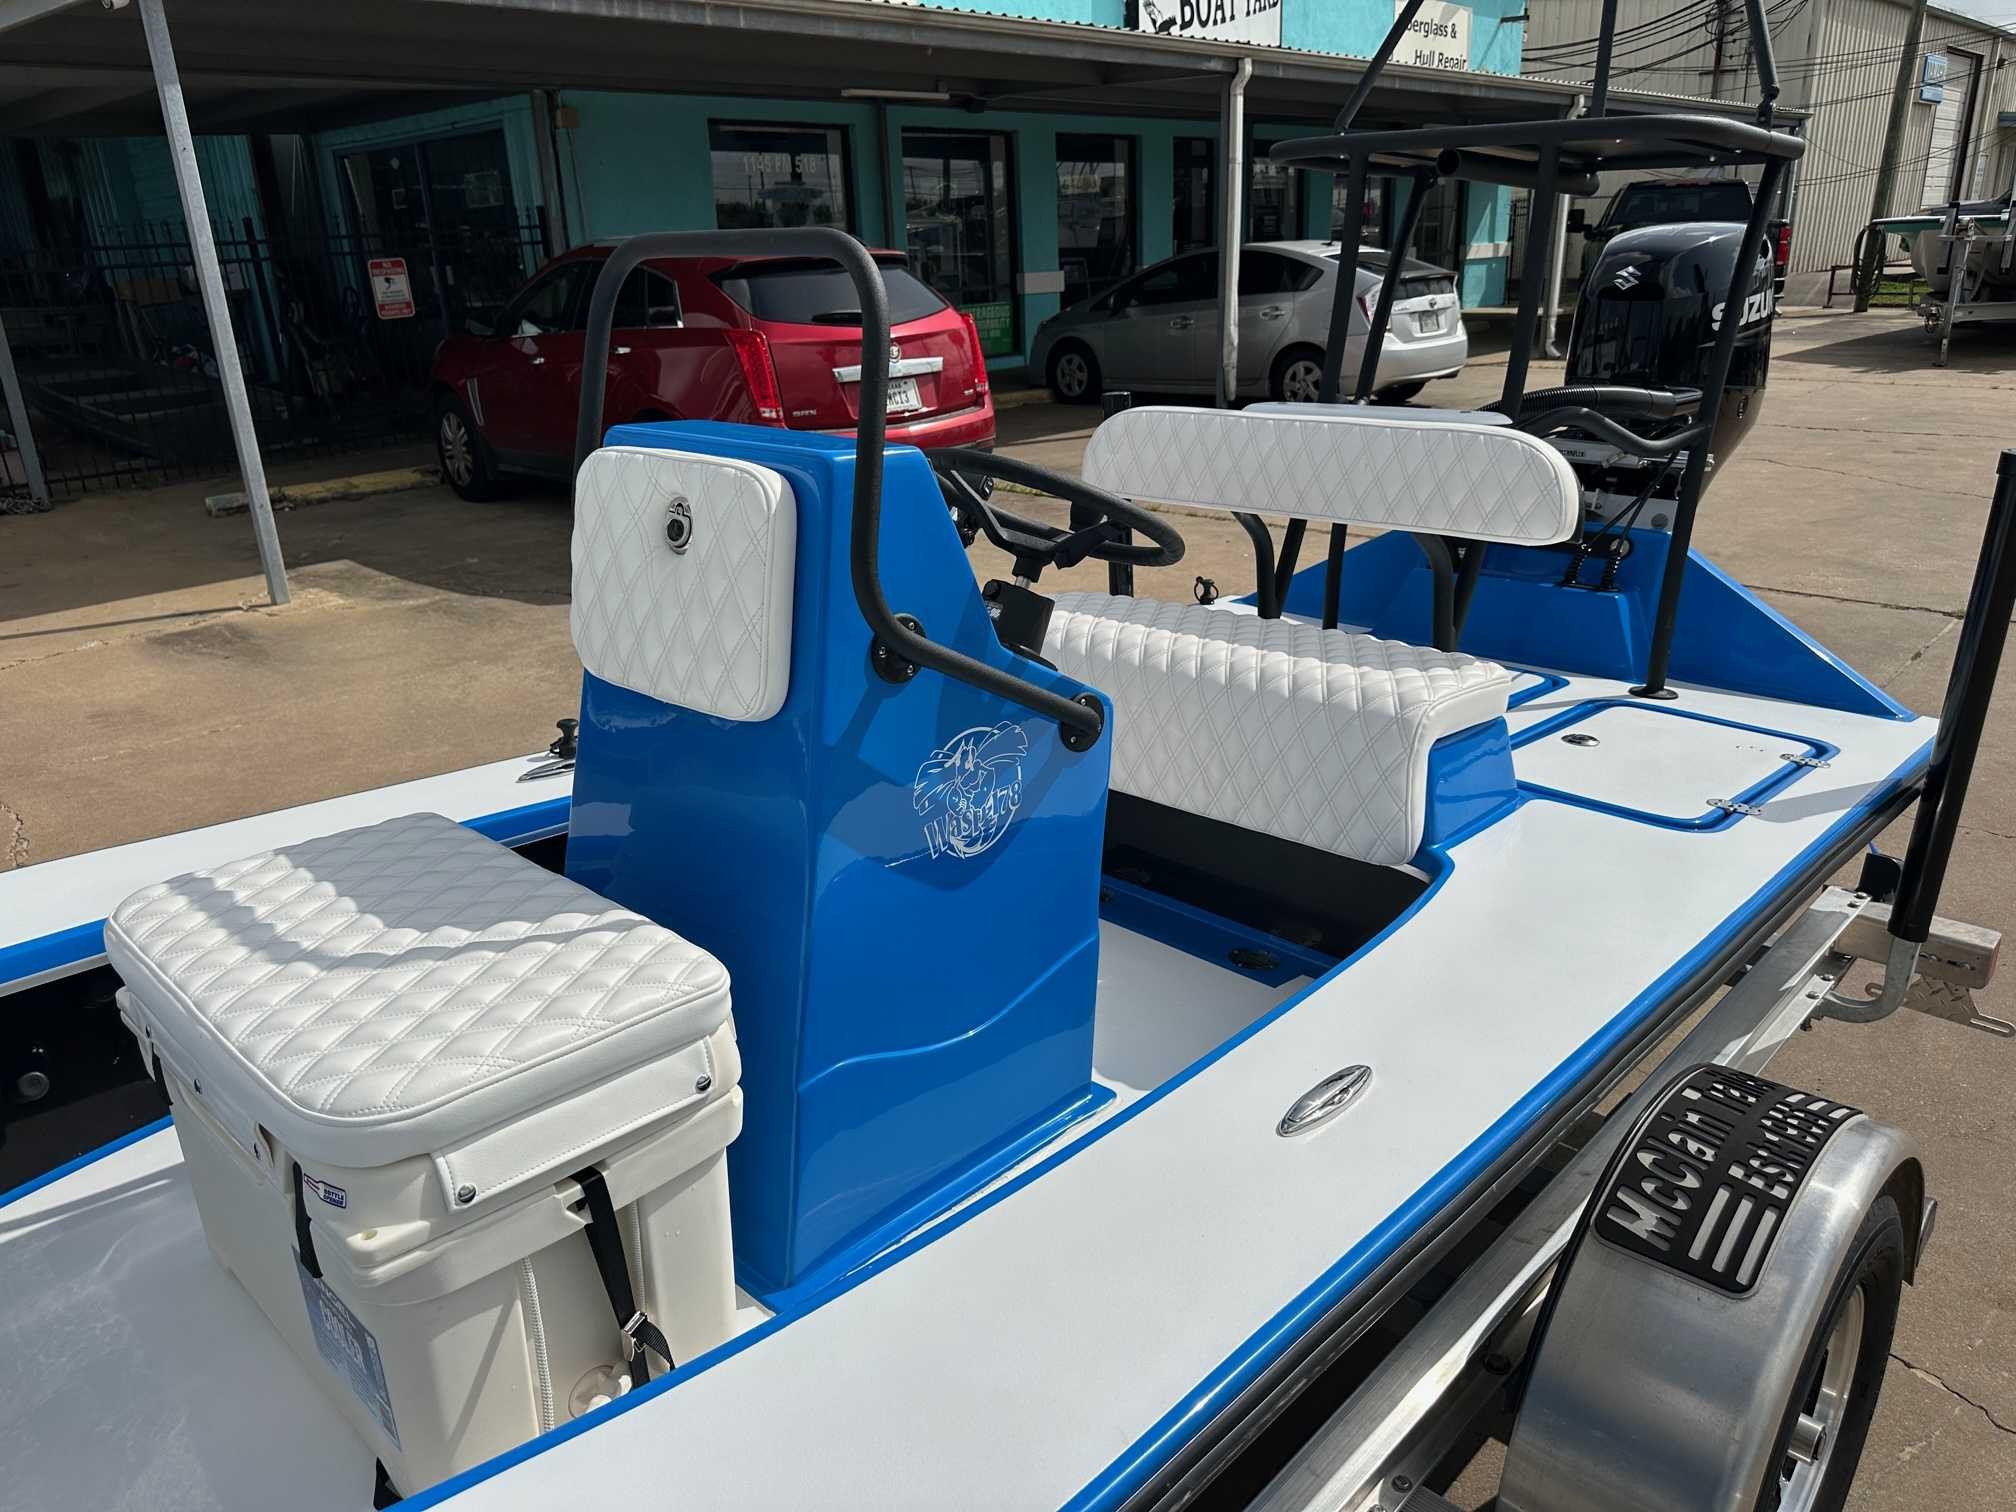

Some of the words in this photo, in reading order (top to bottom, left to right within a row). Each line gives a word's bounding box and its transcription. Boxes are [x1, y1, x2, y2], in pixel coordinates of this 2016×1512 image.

[1407, 18, 1448, 38] erglass
[1450, 23, 1456, 39] &
[1414, 49, 1435, 66] Hull
[1606, 1108, 1735, 1251] McClain
